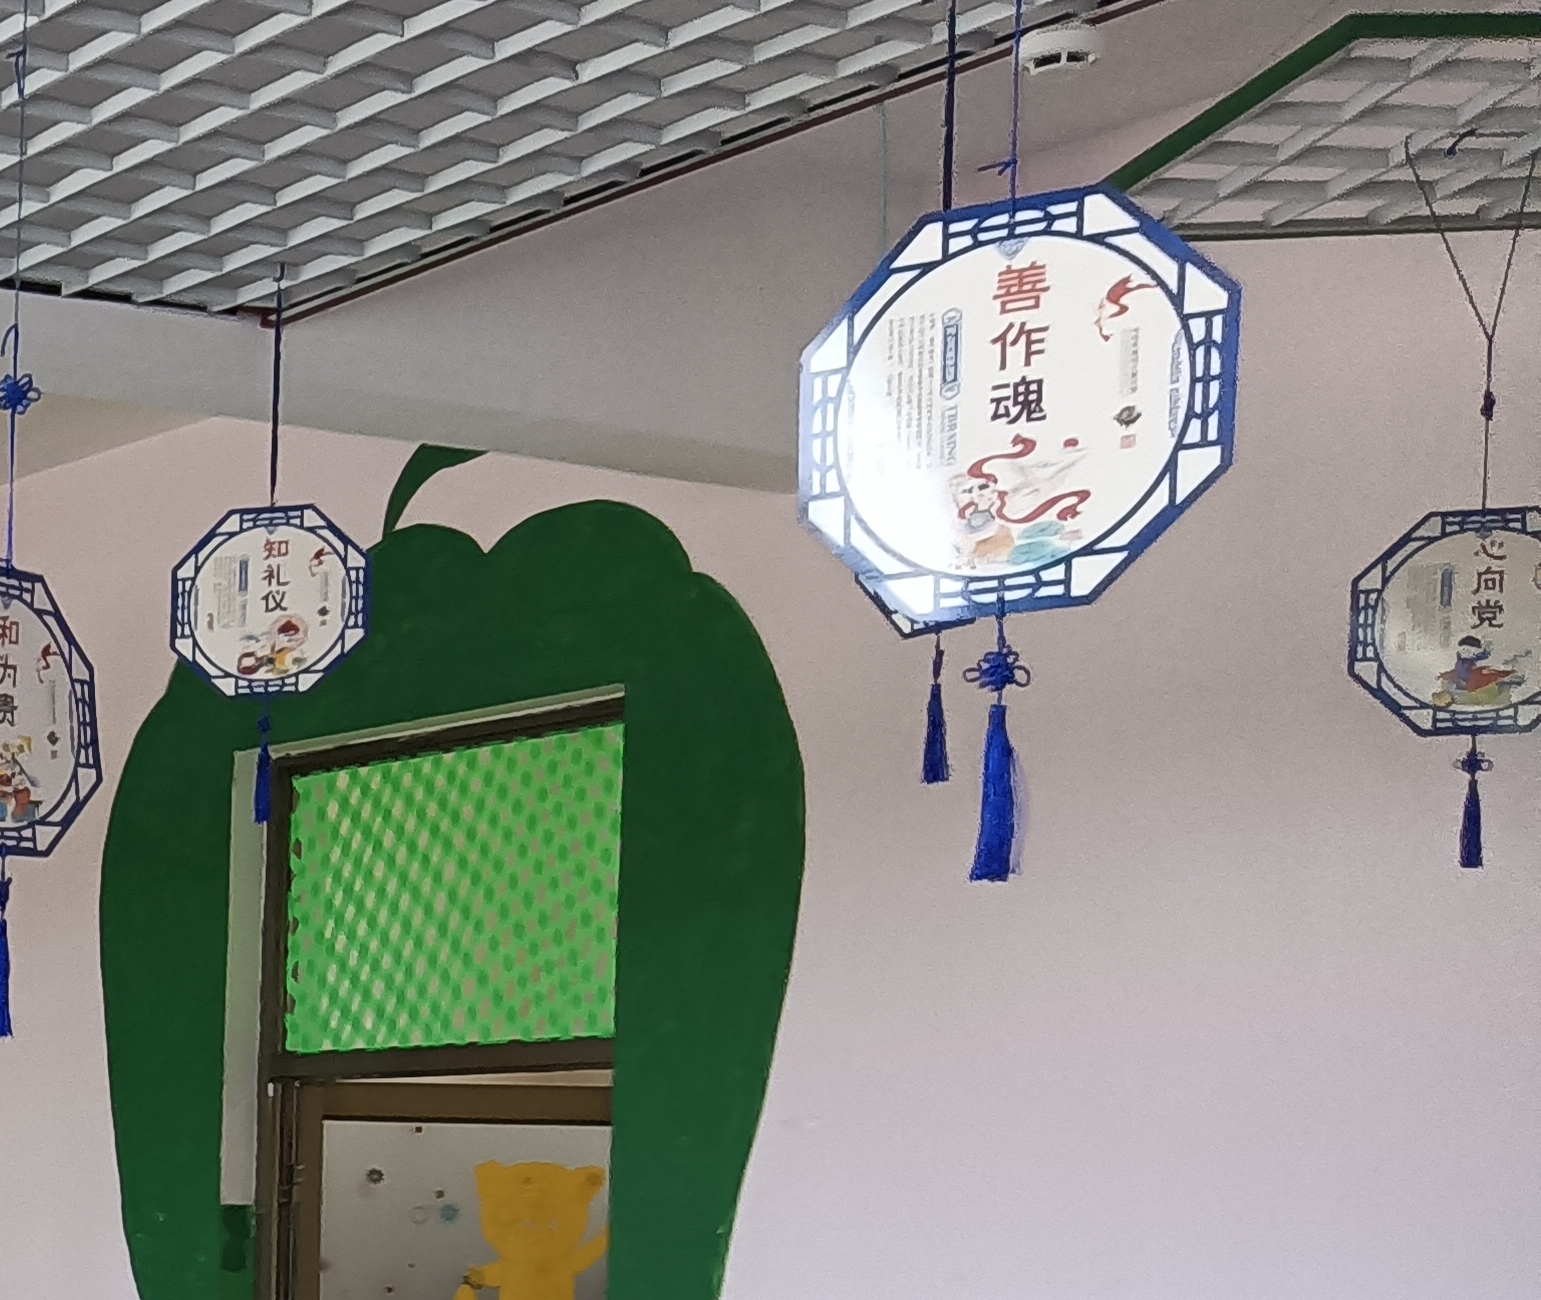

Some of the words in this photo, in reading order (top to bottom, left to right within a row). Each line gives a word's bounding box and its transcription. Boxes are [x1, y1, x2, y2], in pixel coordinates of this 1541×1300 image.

[989, 260, 1051, 426] 善作魂
[261, 538, 291, 614] 知礼仪
[1470, 538, 1508, 630] 心向党
